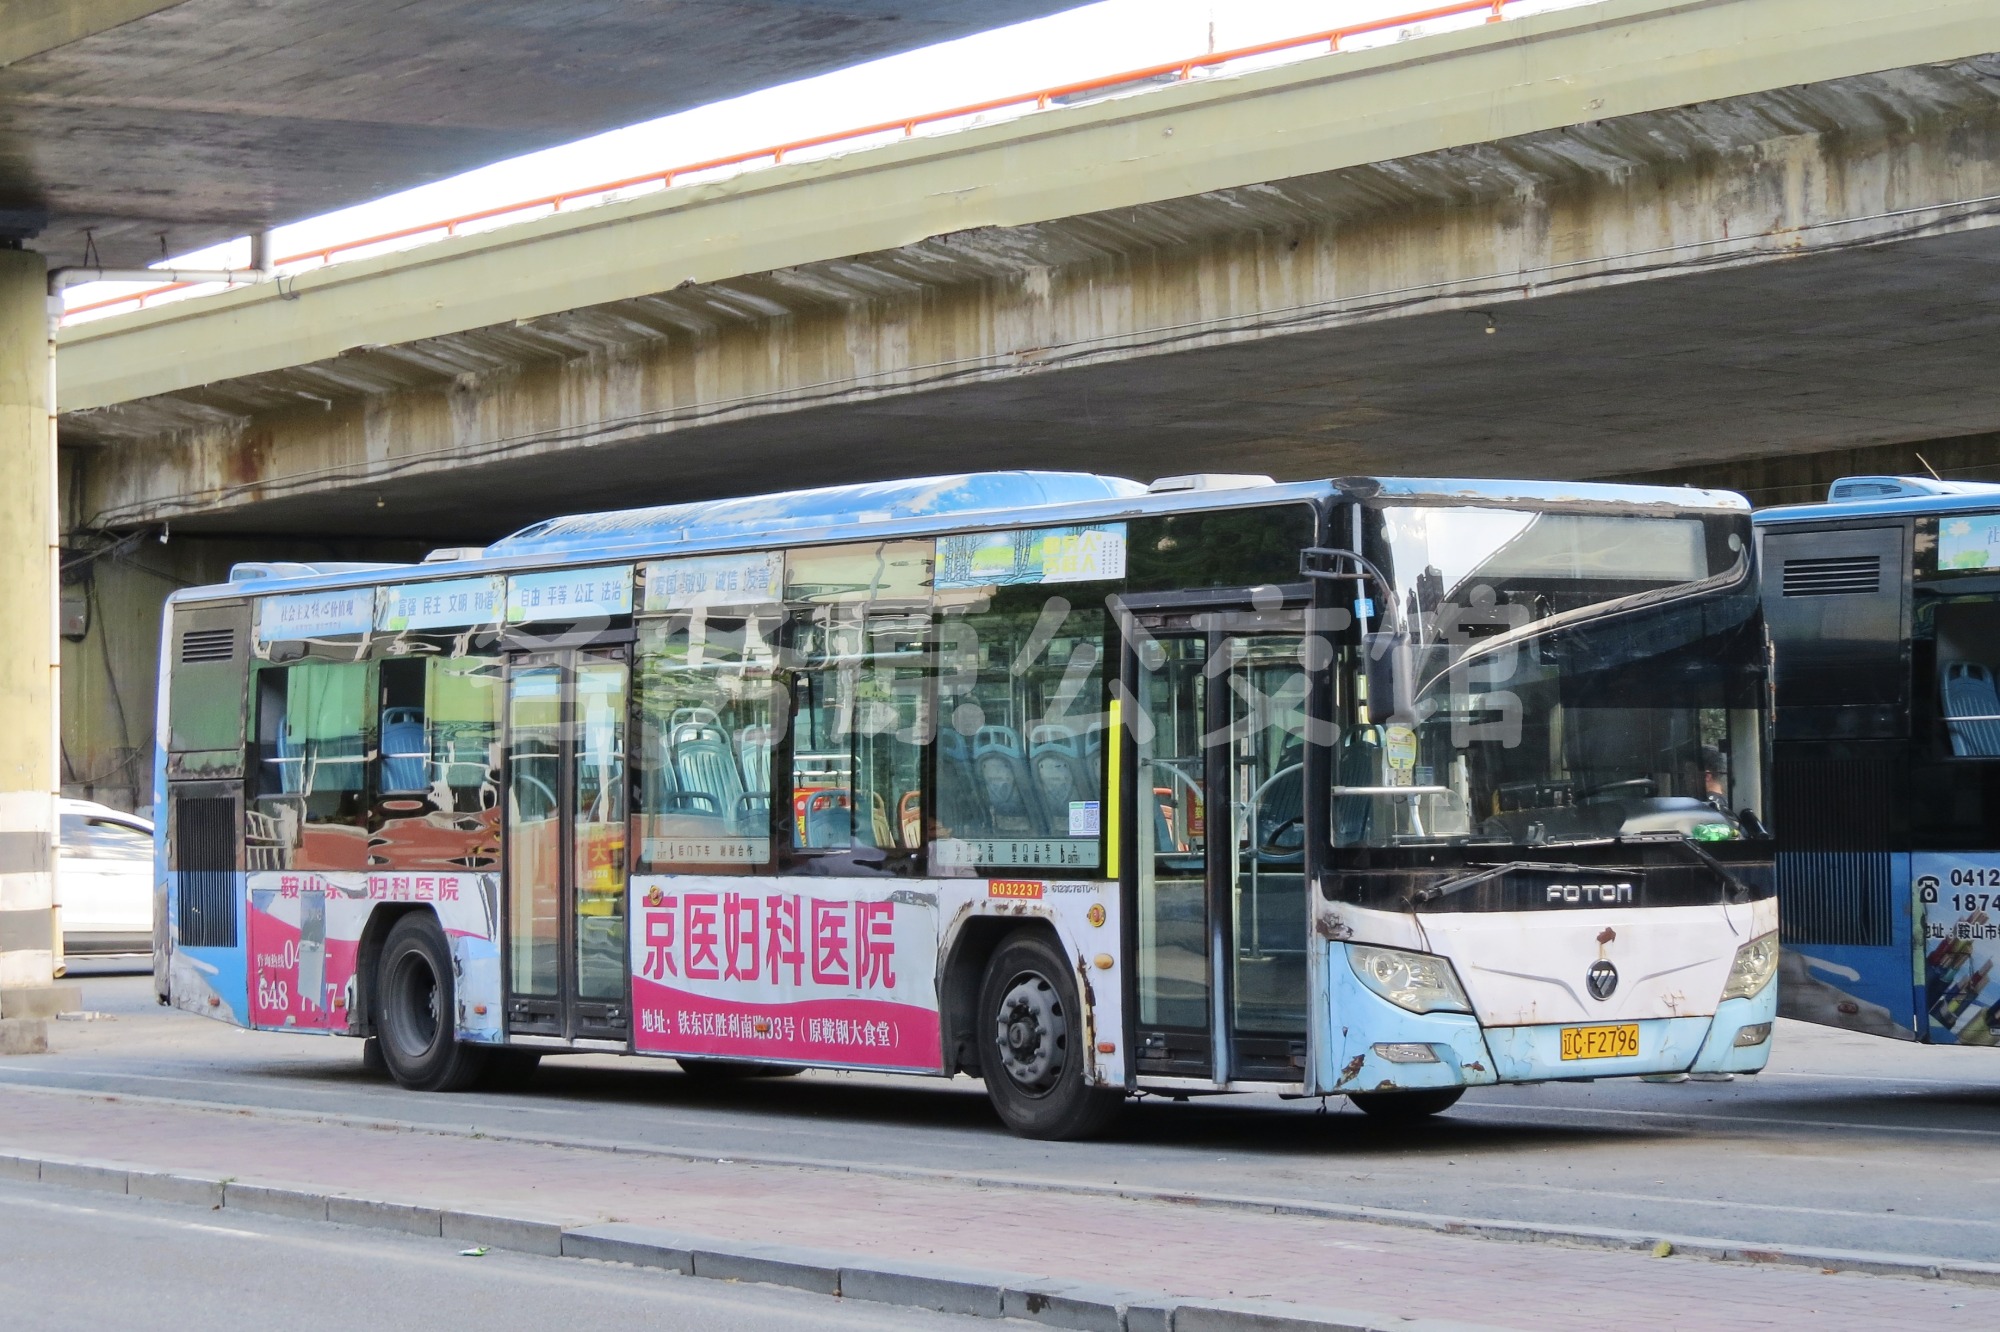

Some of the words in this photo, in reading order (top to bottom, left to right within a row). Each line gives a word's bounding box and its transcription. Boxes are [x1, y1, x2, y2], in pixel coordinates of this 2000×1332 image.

[715, 570, 738, 591] 诚信
[398, 598, 417, 617] 富强
[423, 596, 441, 615] 民主
[448, 593, 467, 613] 文明
[474, 591, 493, 611] 和谐
[521, 587, 540, 607] 自由
[547, 585, 568, 605] 平等
[574, 582, 594, 603] 公正
[601, 581, 621, 601] 法治
[1949, 868, 2000, 887] 0412
[991, 882, 1040, 896] 6032237
[1546, 883, 1633, 903] FOTON
[1951, 893, 2000, 912] 1874
[642, 892, 897, 990] 京医妇科医院
